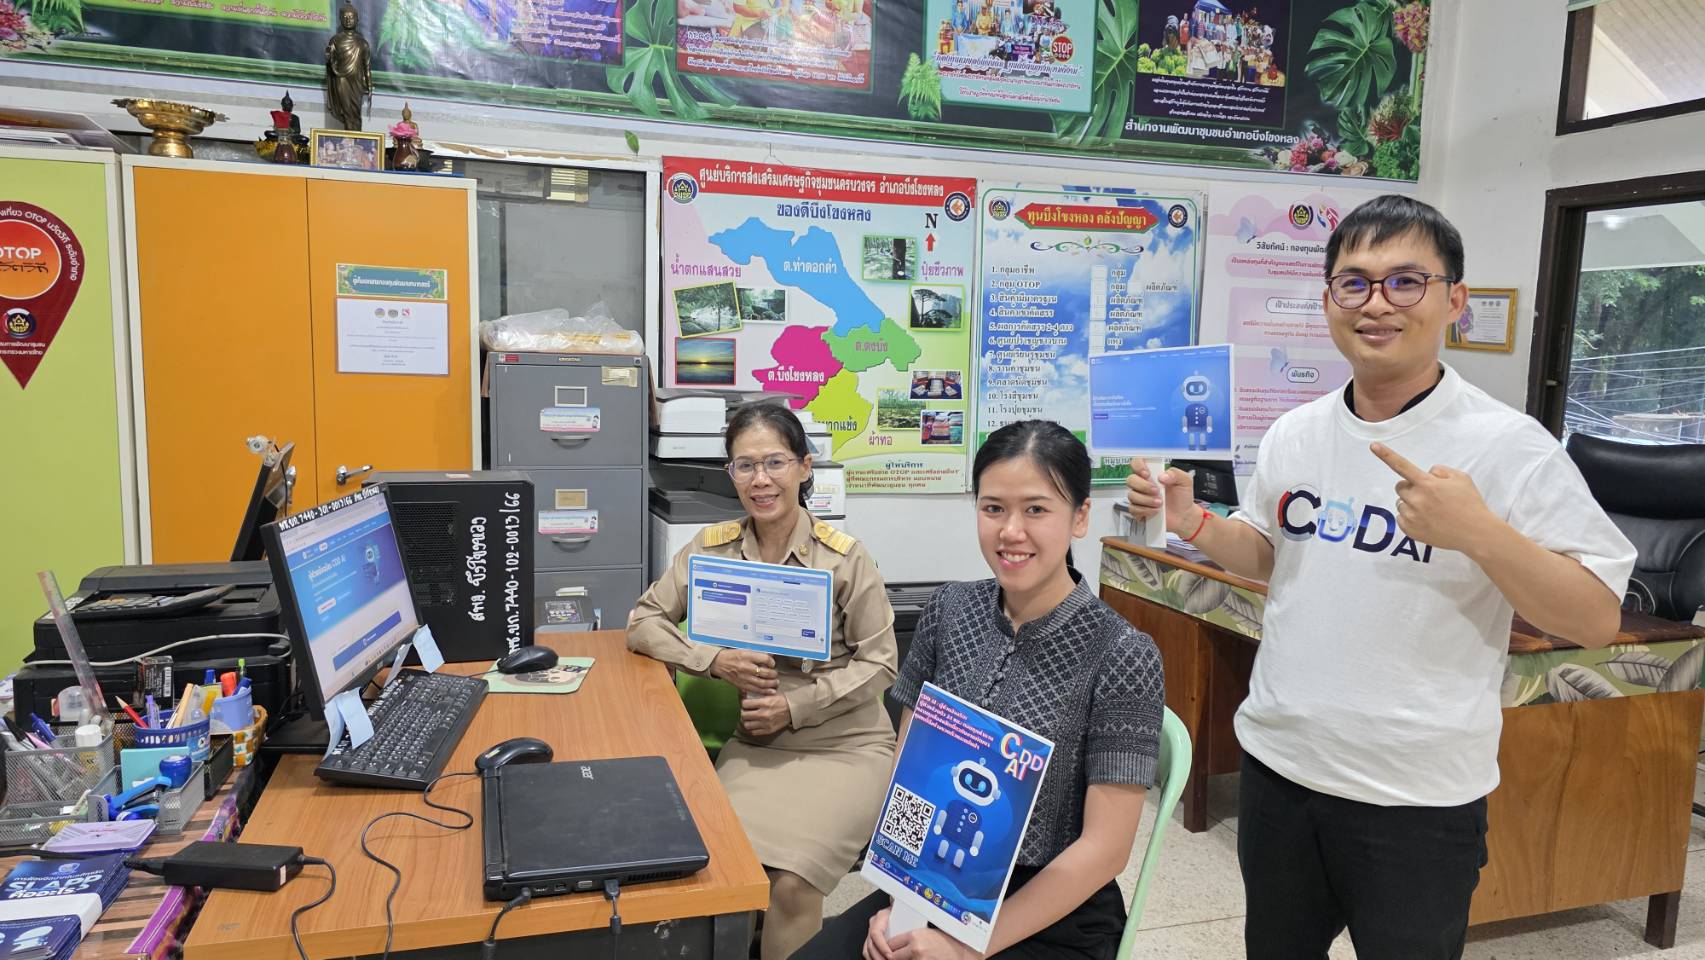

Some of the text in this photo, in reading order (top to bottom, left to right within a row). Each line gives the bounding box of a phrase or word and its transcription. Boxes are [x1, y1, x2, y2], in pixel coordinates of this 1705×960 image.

[1053, 42, 1073, 53] STOP
[699, 164, 944, 197] ศูนย์บริการส่งเสริมเศรษฐกิจชุมชนครบวงจร อำเภอบึงโขงหลง
[25, 211, 47, 224] OTOP
[777, 202, 871, 222] ของดีบึงโขงหลง
[1027, 207, 1147, 230] ทุนบึงโขงหลง คลังปัญญา
[925, 213, 938, 229] N
[0, 246, 42, 259] TOP
[1256, 241, 1285, 251] วิสัยทัศน์
[671, 252, 742, 278] น้ำตกแสนสวย
[783, 257, 837, 274] ต.ท่าดอกคำ
[922, 260, 964, 282] ปุ๋ยชีวภาพ
[768, 365, 825, 382] ต.บึงโขงหลง
[1291, 369, 1315, 379] พันธกิจ
[868, 431, 893, 446] ผ้าทอ
[1000, 733, 1044, 772] CDD
[580, 765, 593, 780] acer
[1004, 758, 1027, 781] AI
[876, 834, 919, 868] SCAN ME
